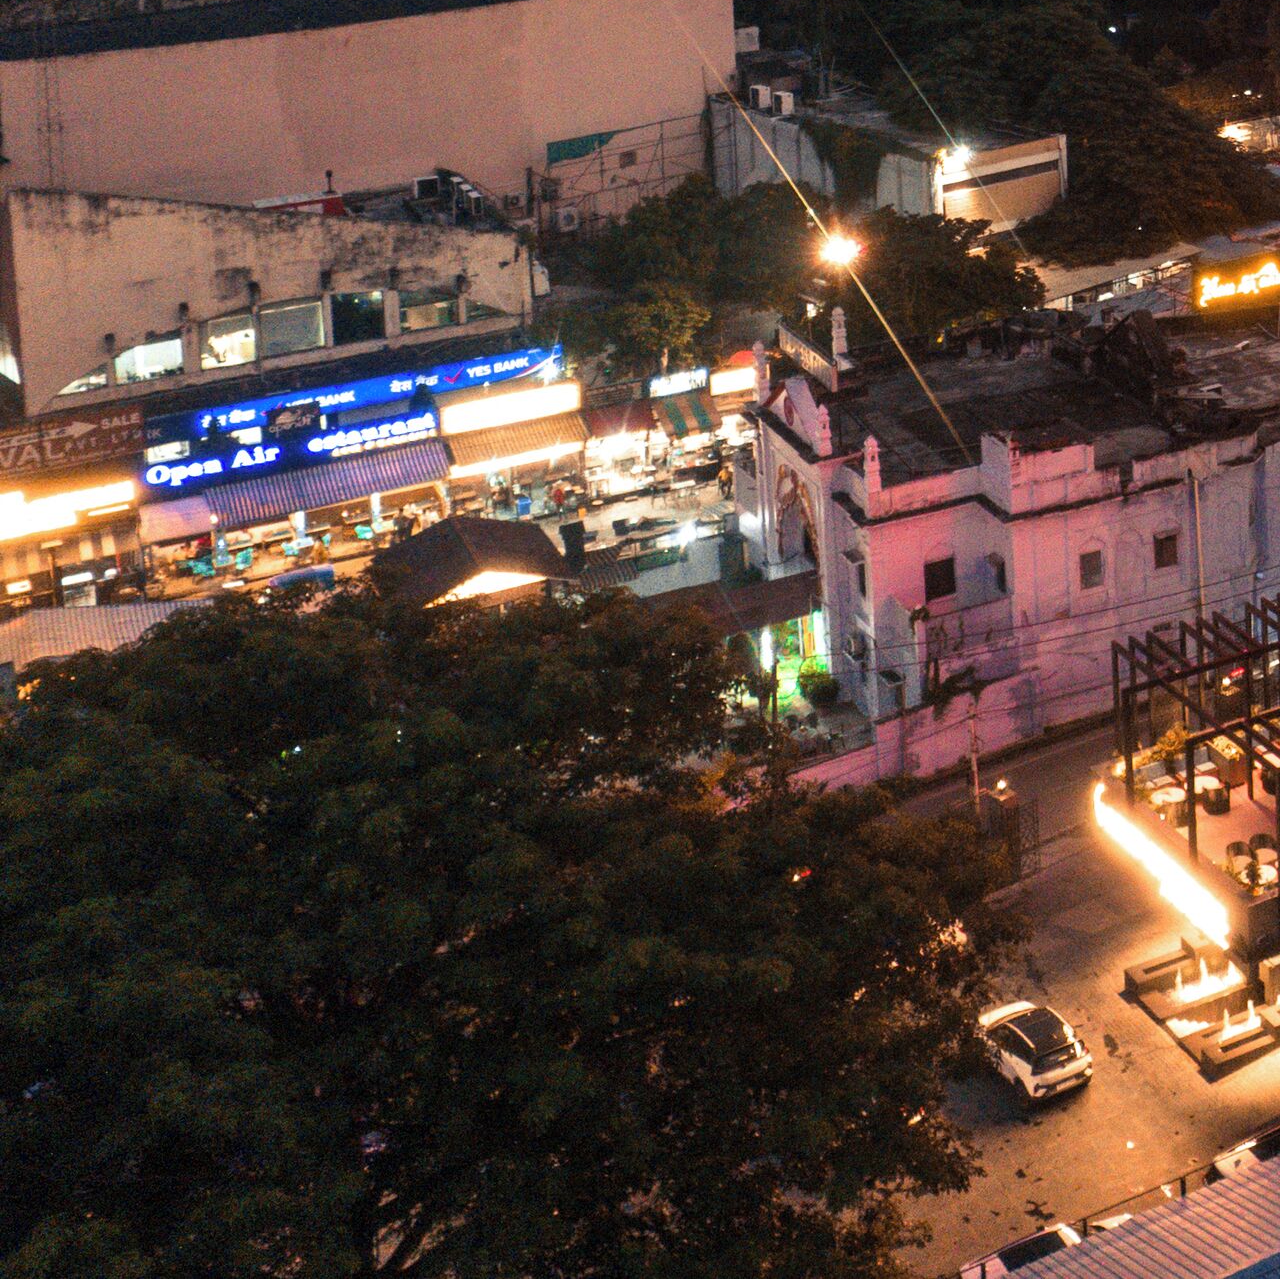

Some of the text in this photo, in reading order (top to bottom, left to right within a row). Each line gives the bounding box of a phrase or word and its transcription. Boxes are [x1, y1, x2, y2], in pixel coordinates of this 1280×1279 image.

[466, 357, 529, 378] YES BANK
[101, 412, 142, 430] SALE
[145, 459, 223, 487] Open
[231, 446, 280, 468] Air
